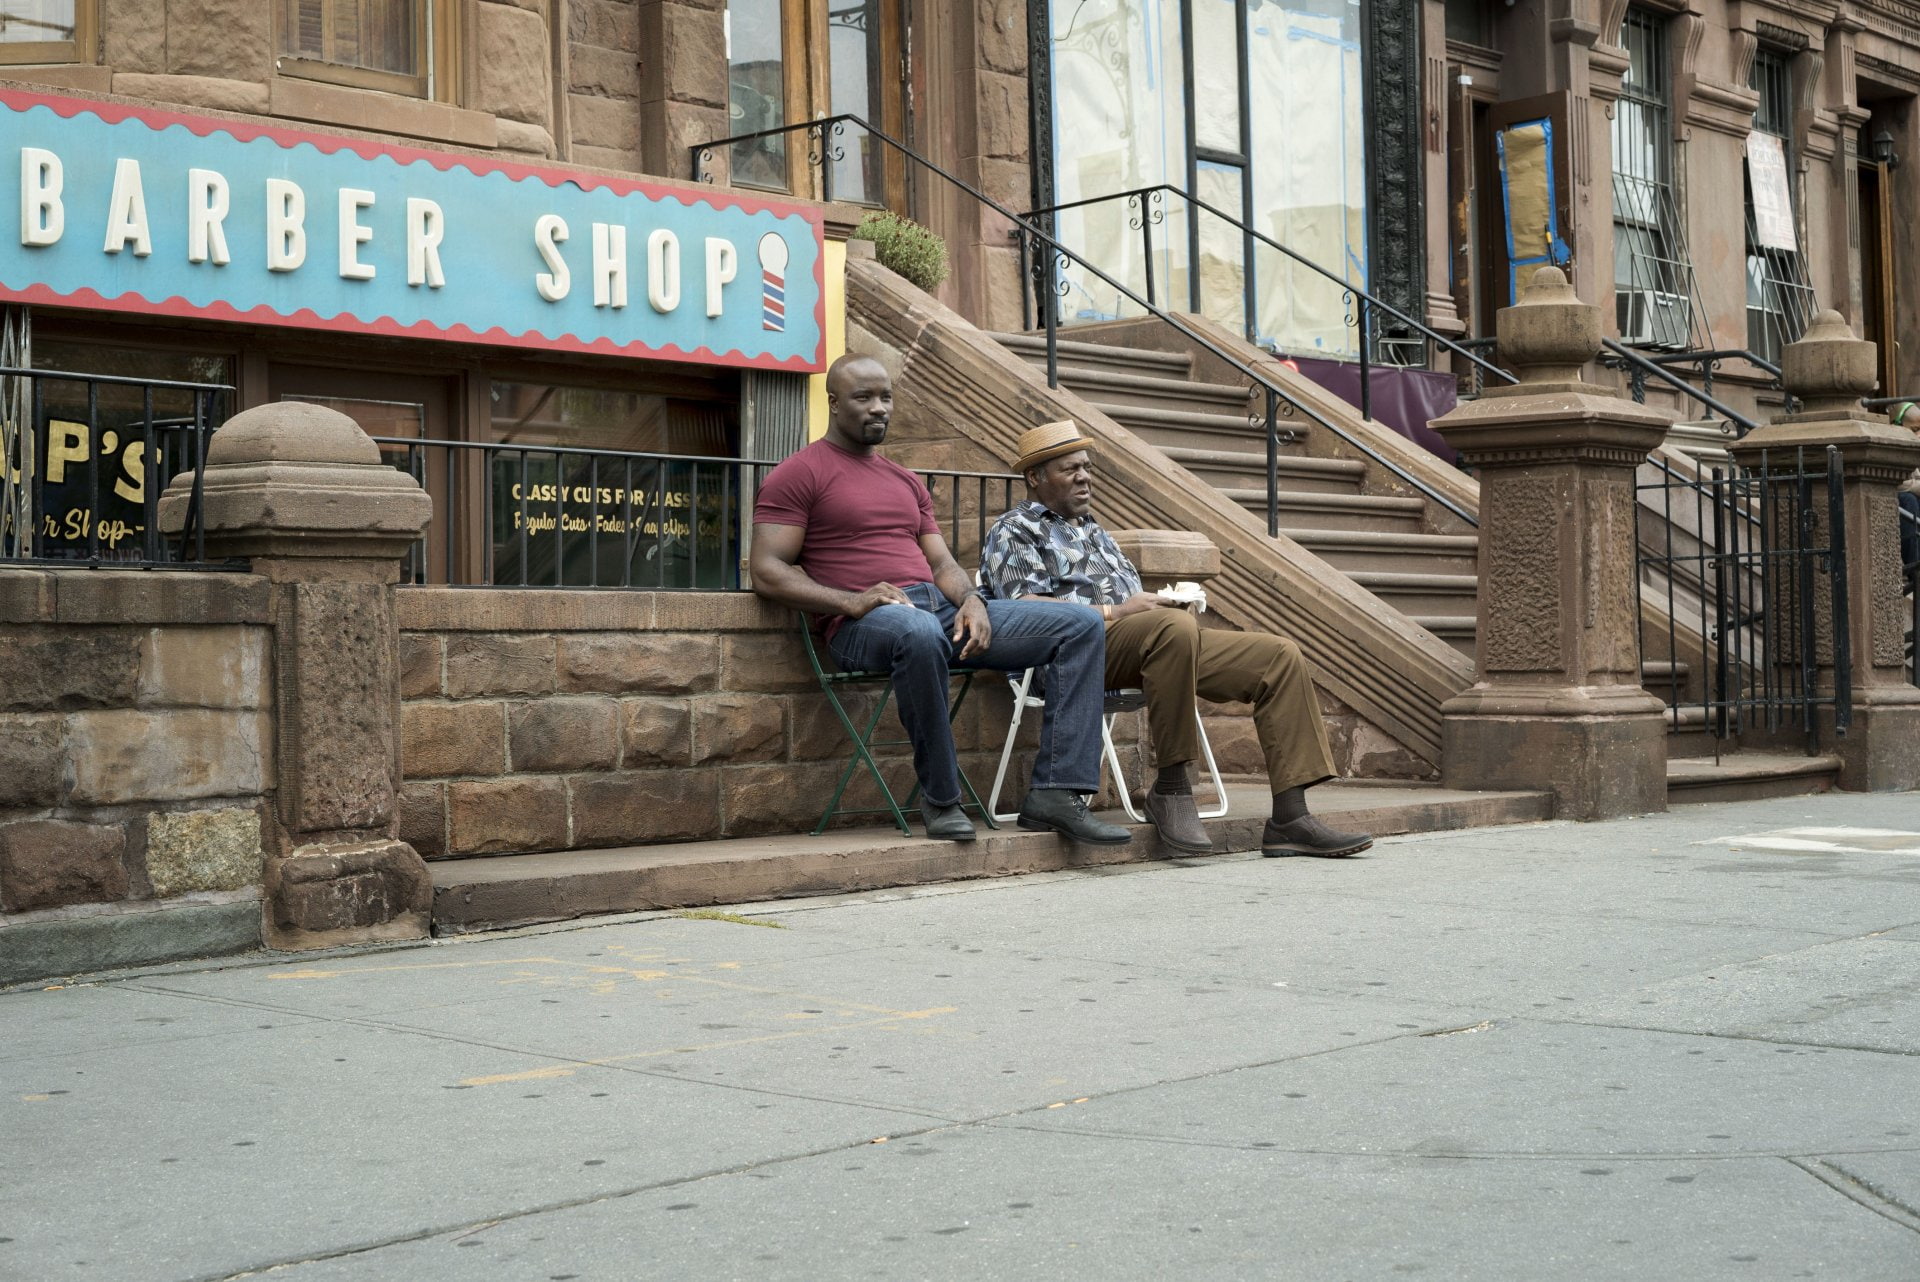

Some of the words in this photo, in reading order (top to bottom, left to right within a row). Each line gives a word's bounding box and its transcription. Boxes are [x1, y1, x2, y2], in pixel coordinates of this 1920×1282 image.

[21, 147, 446, 289] BARBER
[535, 214, 738, 318] SHOP
[573, 486, 612, 504] CUTS
[561, 513, 588, 532] Cuts
